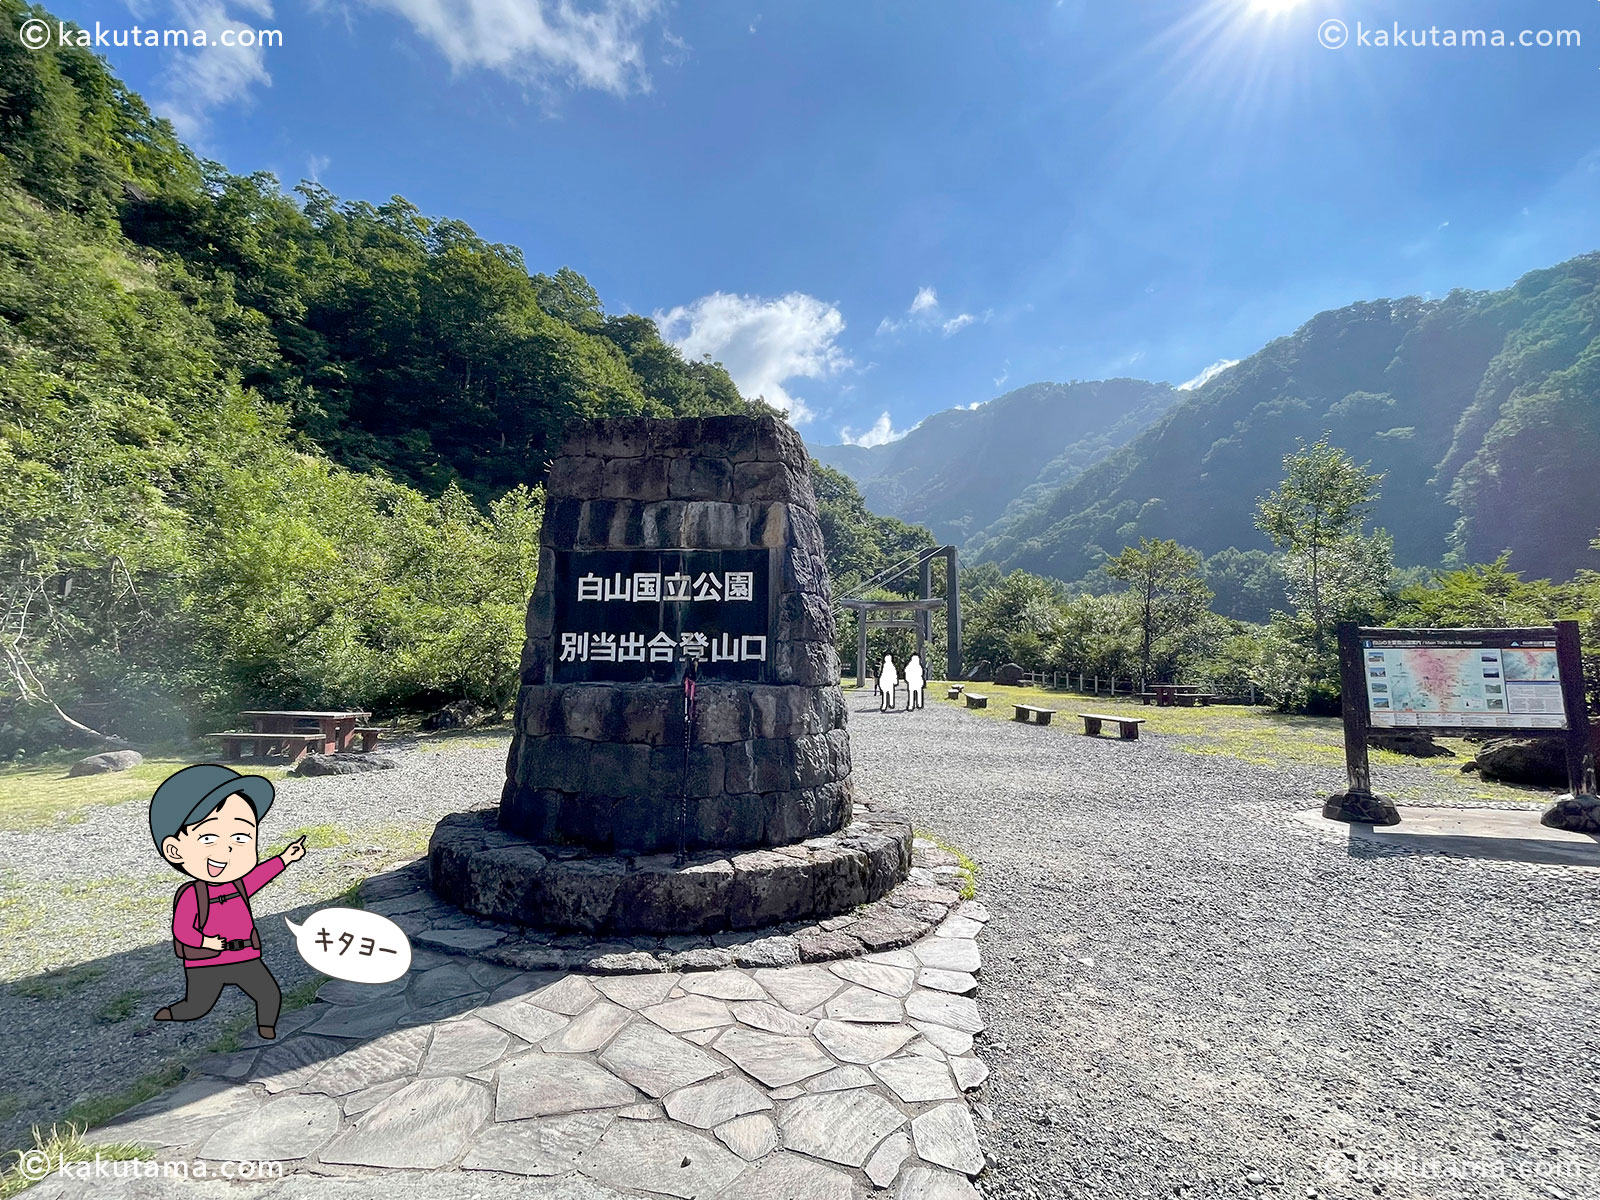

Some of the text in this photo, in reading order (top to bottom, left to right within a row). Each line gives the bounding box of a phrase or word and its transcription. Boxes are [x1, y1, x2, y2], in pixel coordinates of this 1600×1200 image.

[577, 572, 754, 603] 白山国立公園
[559, 631, 768, 663] 別当出合登山口
